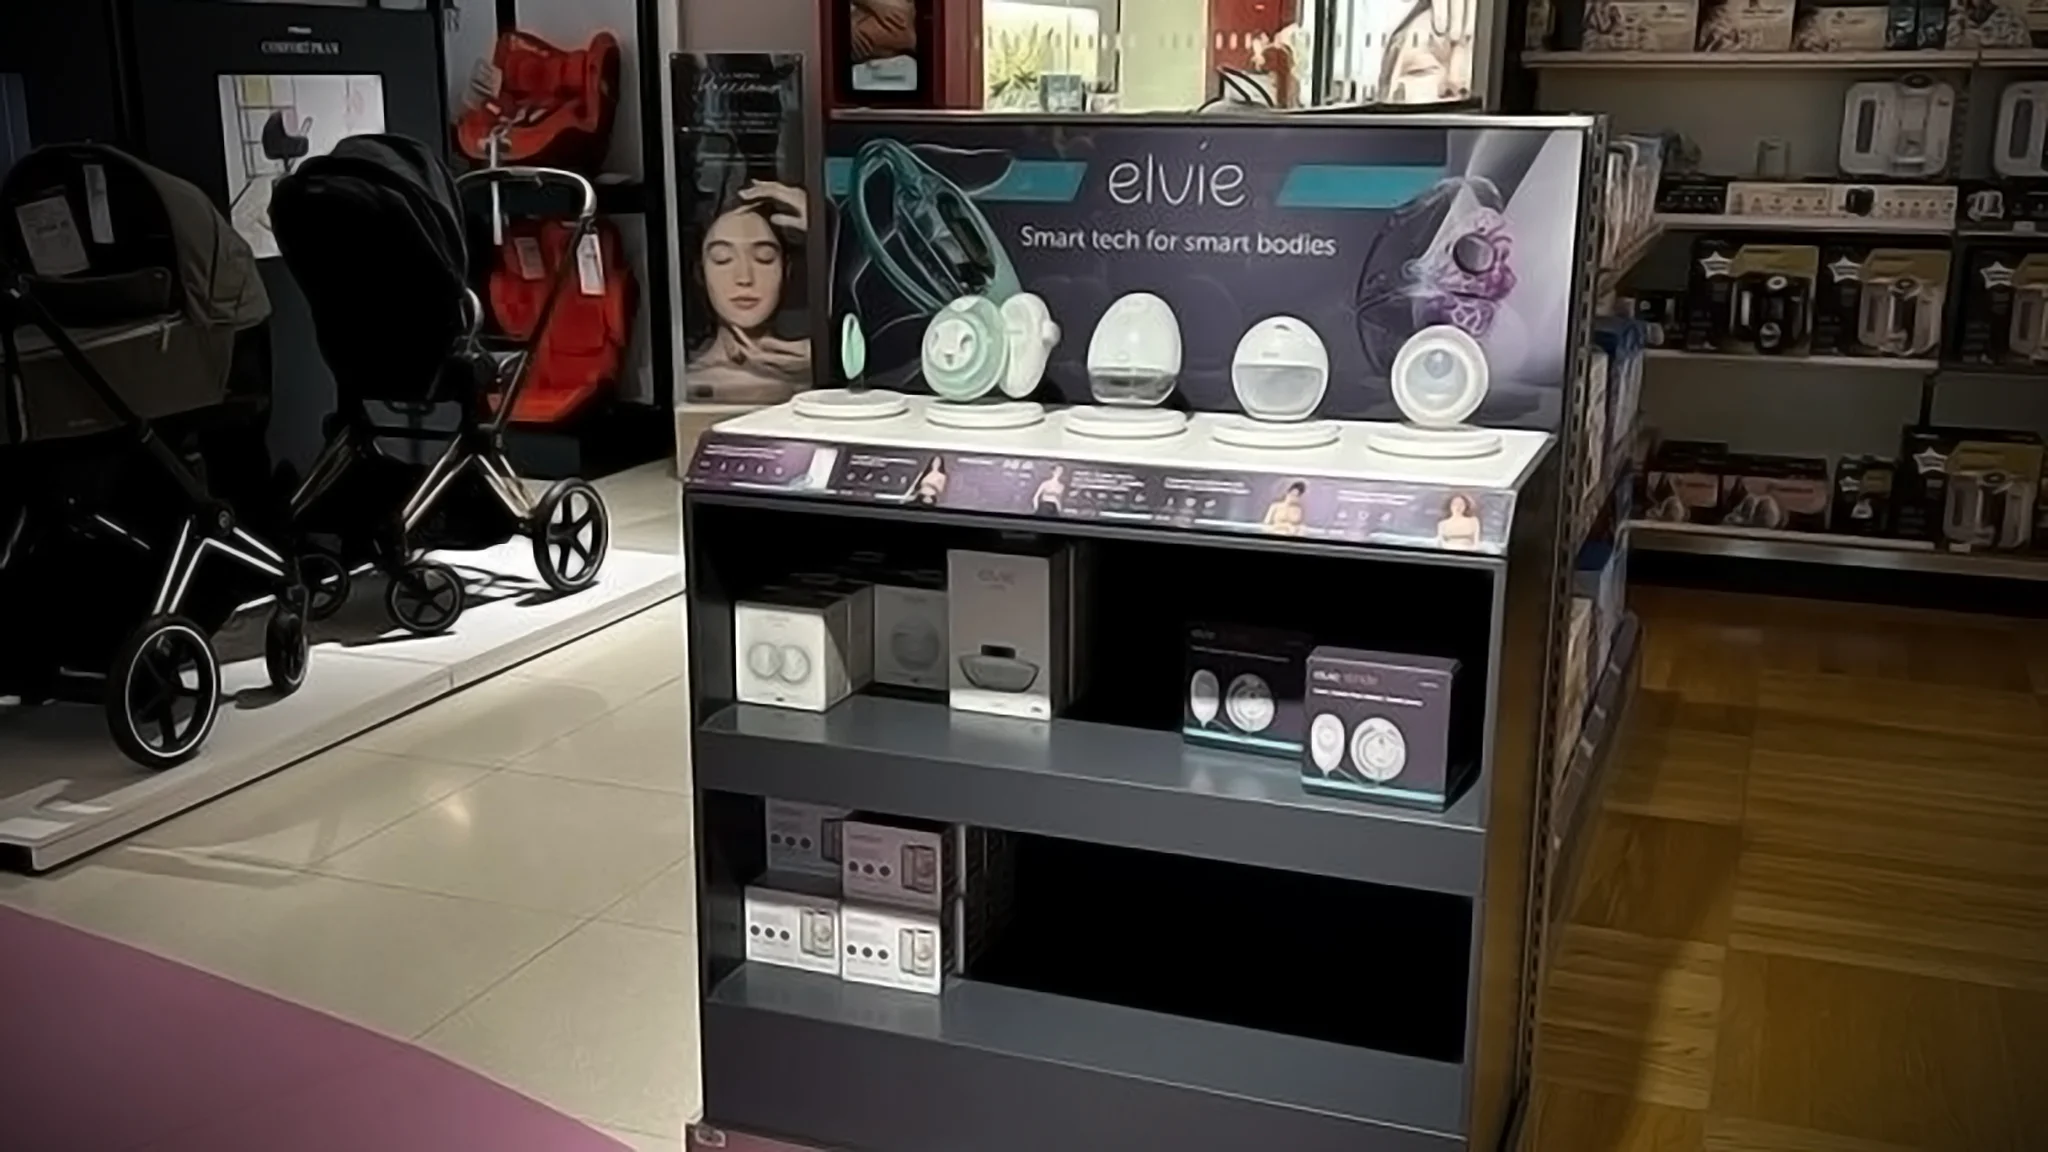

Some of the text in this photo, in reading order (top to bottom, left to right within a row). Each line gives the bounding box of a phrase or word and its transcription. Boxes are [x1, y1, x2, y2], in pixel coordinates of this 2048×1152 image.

[1108, 140, 1247, 207] elvie
[1020, 225, 1337, 255] Smart tech for smart bodies
